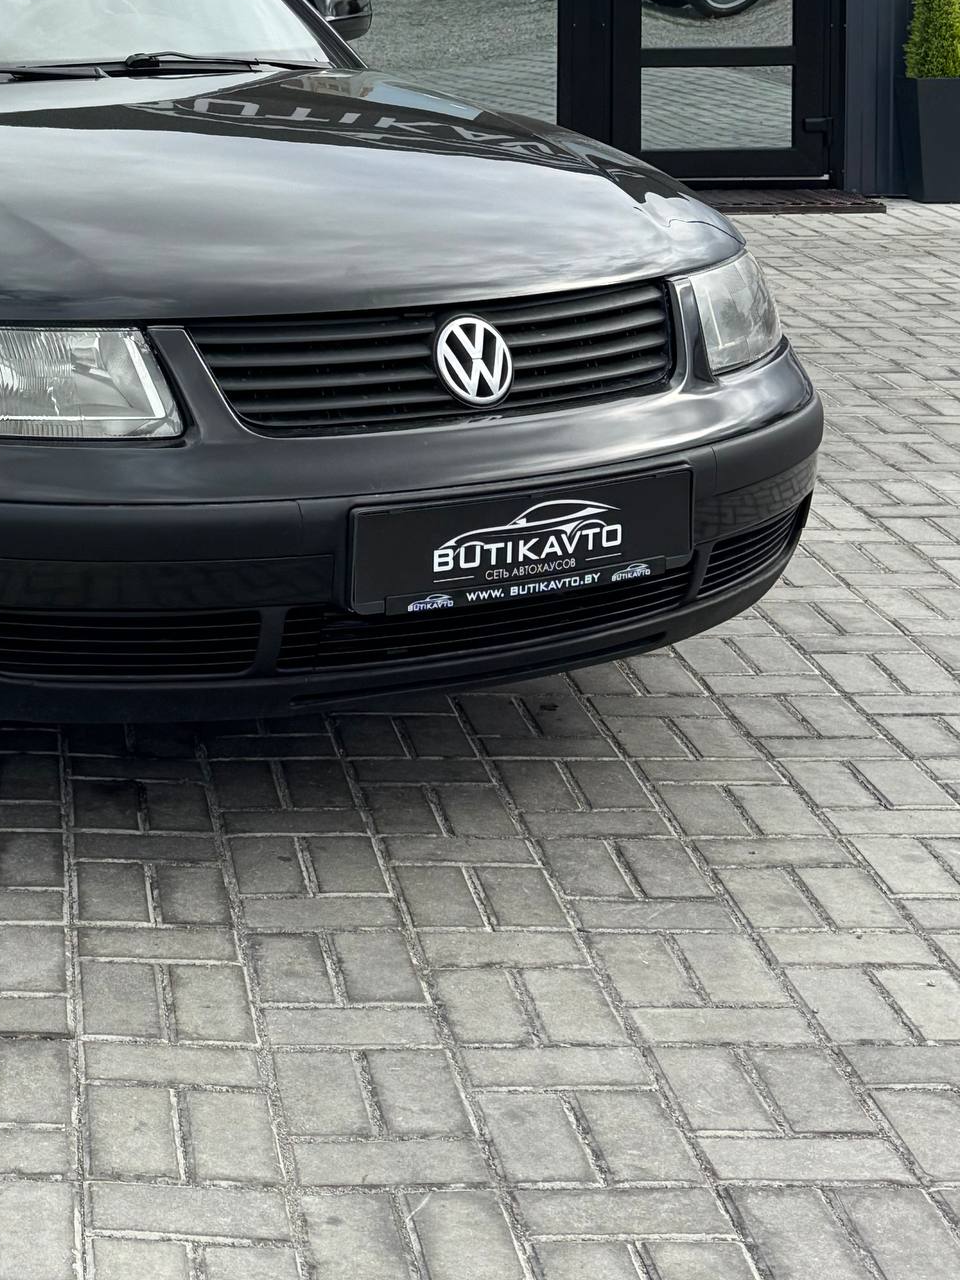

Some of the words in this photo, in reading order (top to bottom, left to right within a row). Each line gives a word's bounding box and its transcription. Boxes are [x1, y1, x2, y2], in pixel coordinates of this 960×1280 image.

[433, 524, 622, 573] BUTIKAVTO
[485, 569, 510, 581] СЕТЬ
[511, 558, 576, 578] АВТОХАУСОВ
[611, 568, 651, 582] BUTIKAVTO
[510, 572, 601, 597] BUTIKAVTO.BY
[407, 599, 454, 612] BUTIKAVTO
